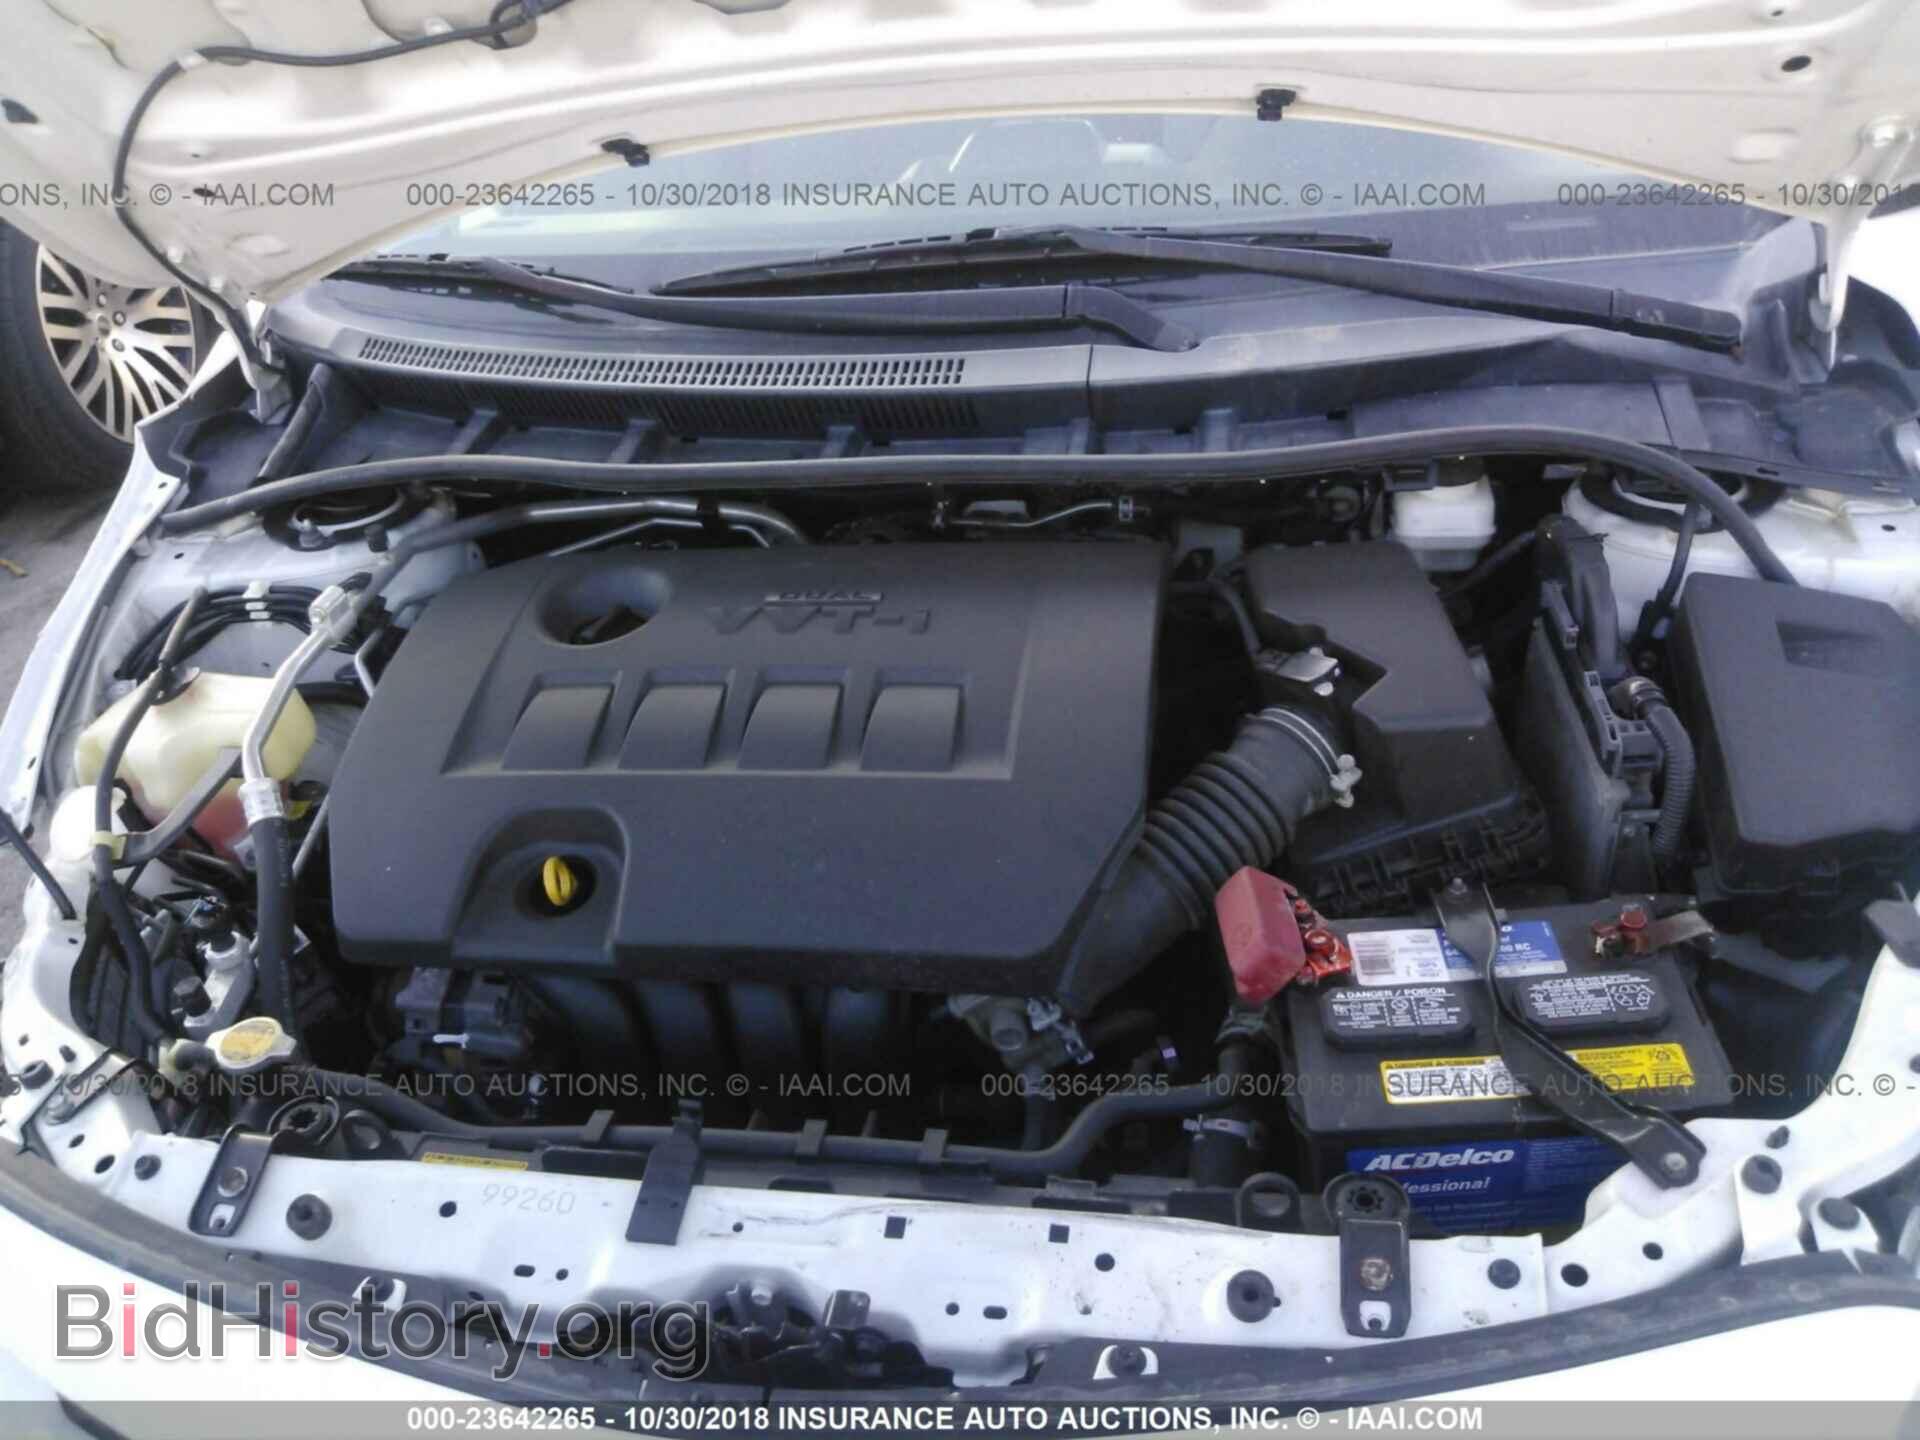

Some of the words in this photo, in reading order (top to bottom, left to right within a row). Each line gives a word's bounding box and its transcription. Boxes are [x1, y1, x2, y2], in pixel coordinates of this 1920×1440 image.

[1347, 988, 1392, 1000] DANGER
[1404, 987, 1446, 997] POISON
[1365, 1148, 1515, 1171] ACDelco
